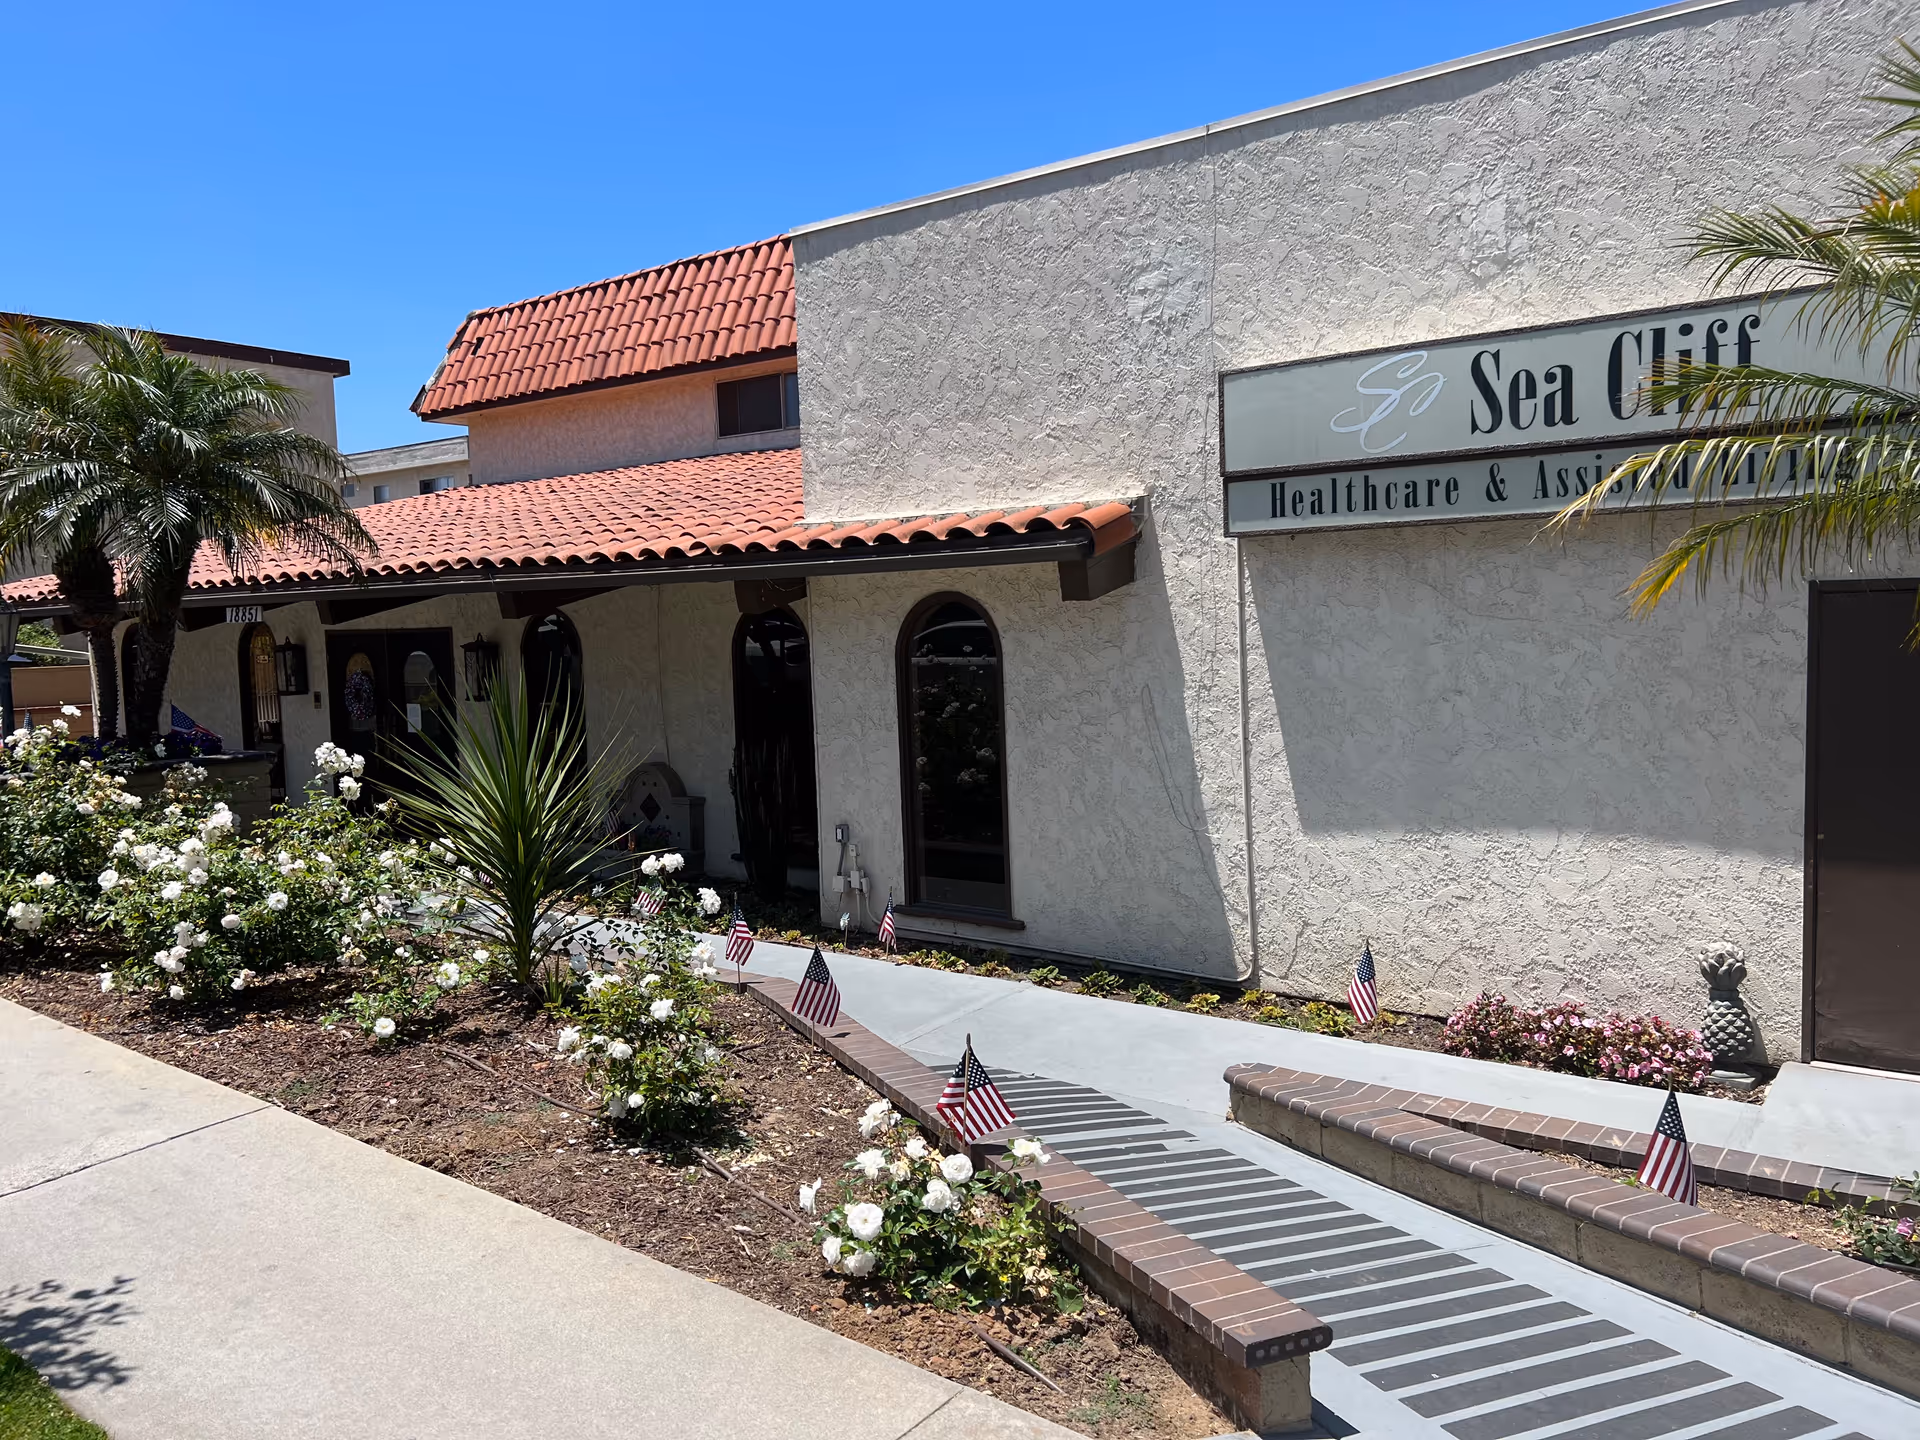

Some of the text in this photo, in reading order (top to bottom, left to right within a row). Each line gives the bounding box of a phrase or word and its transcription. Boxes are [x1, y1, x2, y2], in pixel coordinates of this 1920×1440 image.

[1470, 314, 1761, 435] Sea Cliff
[1270, 474, 1460, 519] Healthcare
[1485, 462, 1509, 503] &
[229, 606, 259, 622] 18851
